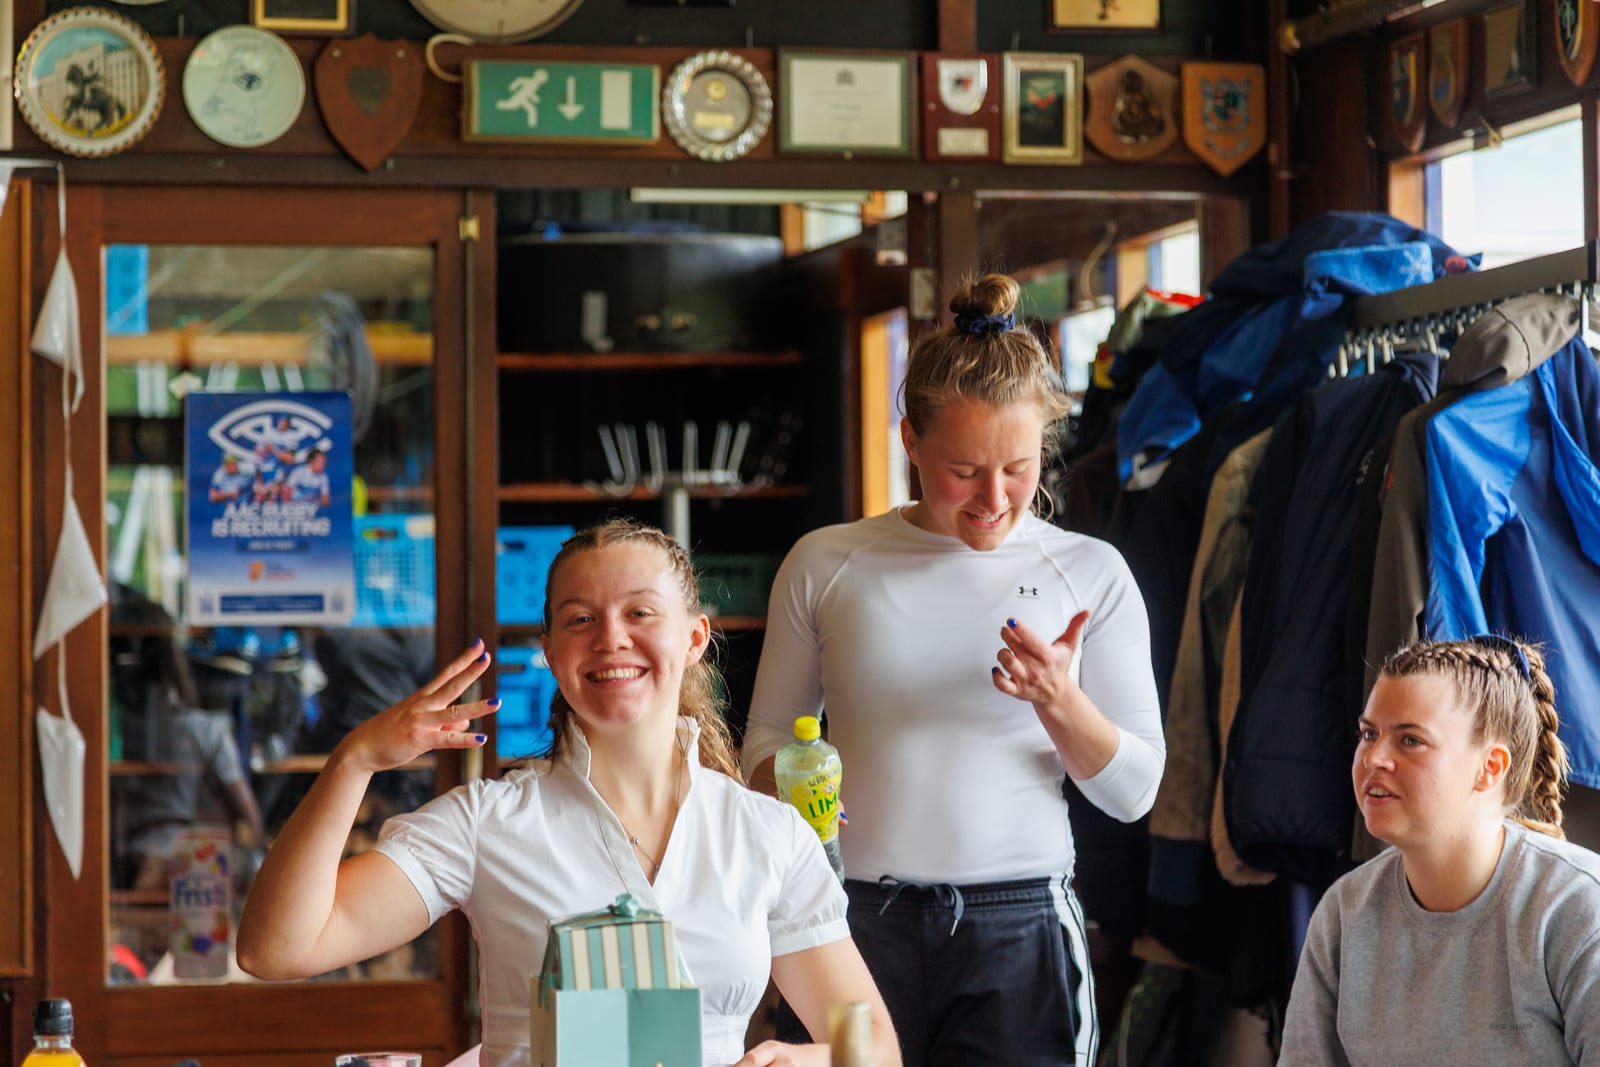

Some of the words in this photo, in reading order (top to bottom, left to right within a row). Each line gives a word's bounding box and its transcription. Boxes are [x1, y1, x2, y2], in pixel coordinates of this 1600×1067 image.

[224, 502, 261, 520] AAC
[262, 502, 319, 519] RUGBY
[212, 518, 229, 538] IS
[230, 518, 331, 538] RECRUITING
[808, 789, 840, 818] LIM
